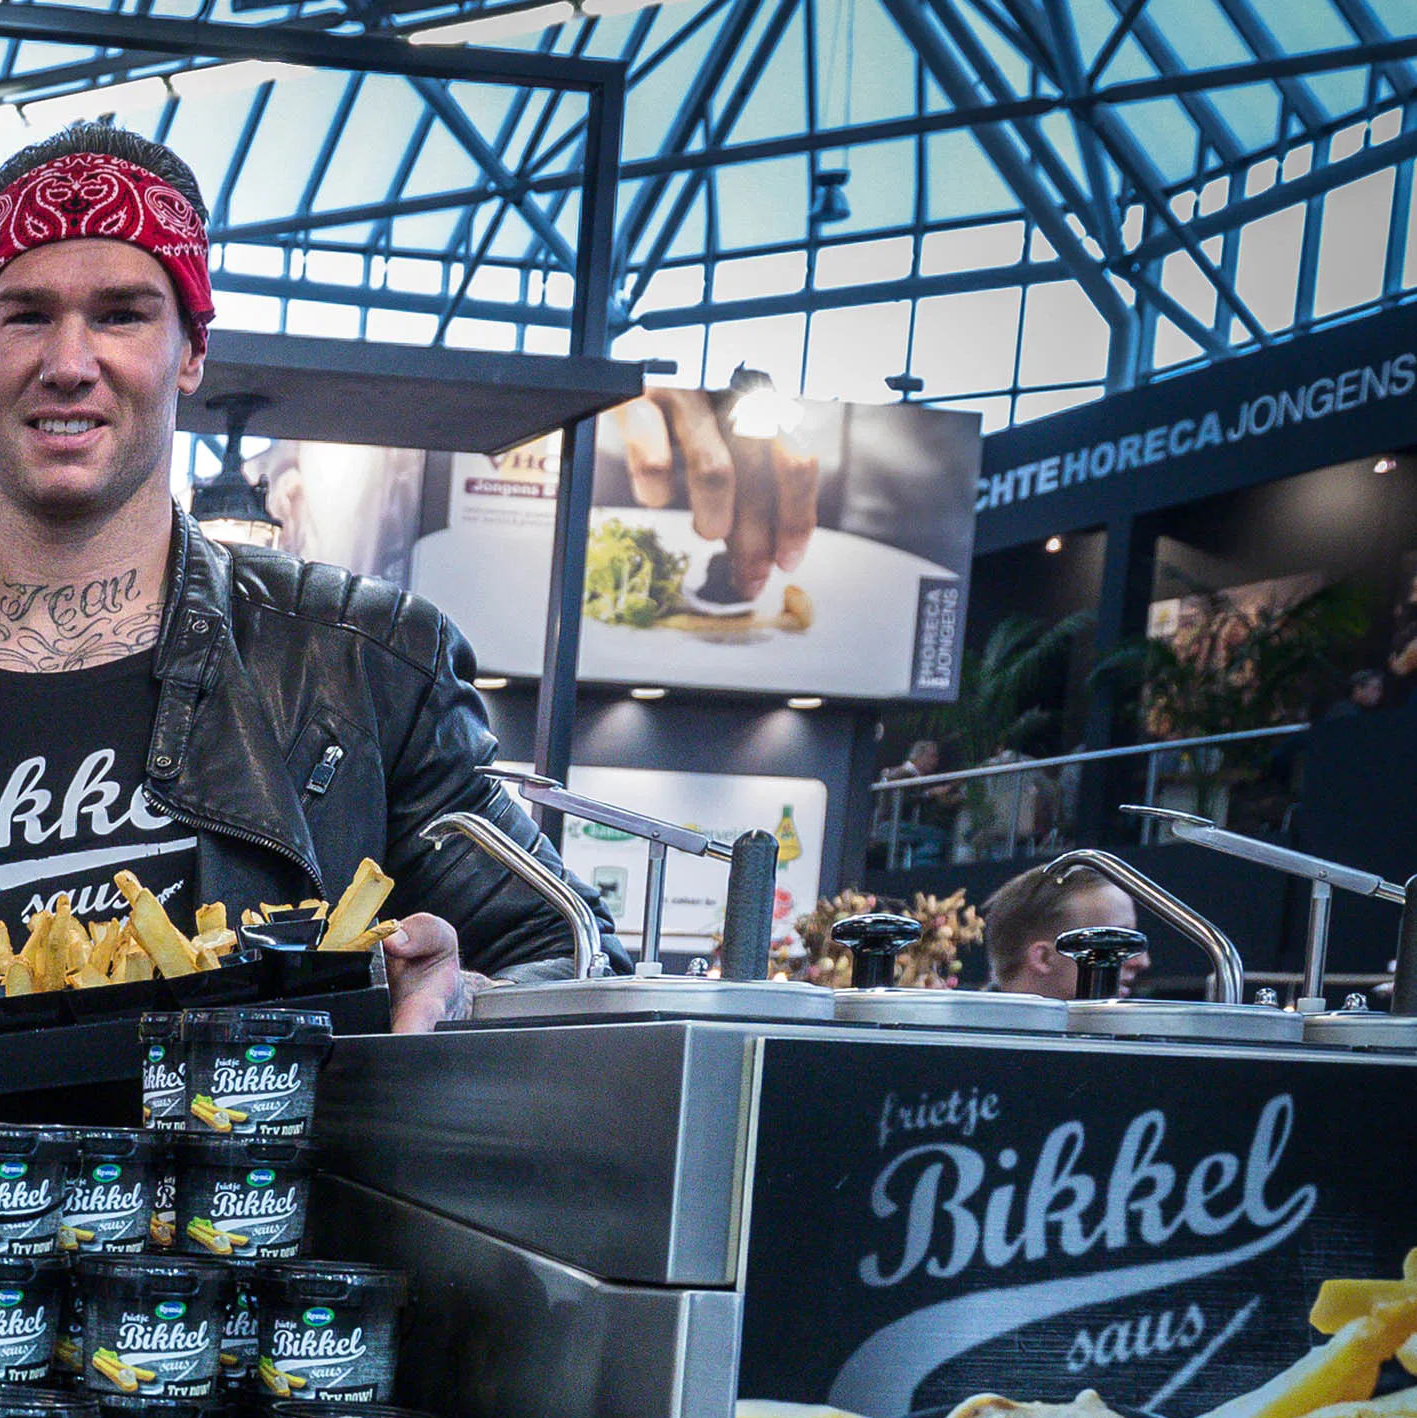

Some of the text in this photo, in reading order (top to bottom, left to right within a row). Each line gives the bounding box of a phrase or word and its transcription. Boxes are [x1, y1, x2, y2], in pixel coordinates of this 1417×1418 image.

[1065, 411, 1224, 485] HORECA
[1226, 353, 1416, 442] JONGENS
[211, 1062, 302, 1094] Bikkel
[877, 1087, 1001, 1148] frietje
[63, 1182, 144, 1212] Bikkel
[210, 1187, 297, 1216] Bikkel
[860, 1092, 1318, 1288] Bikkel
[116, 1320, 210, 1350] Bikkel
[272, 1328, 367, 1357] Bikkel
[1068, 1302, 1206, 1374] saus
